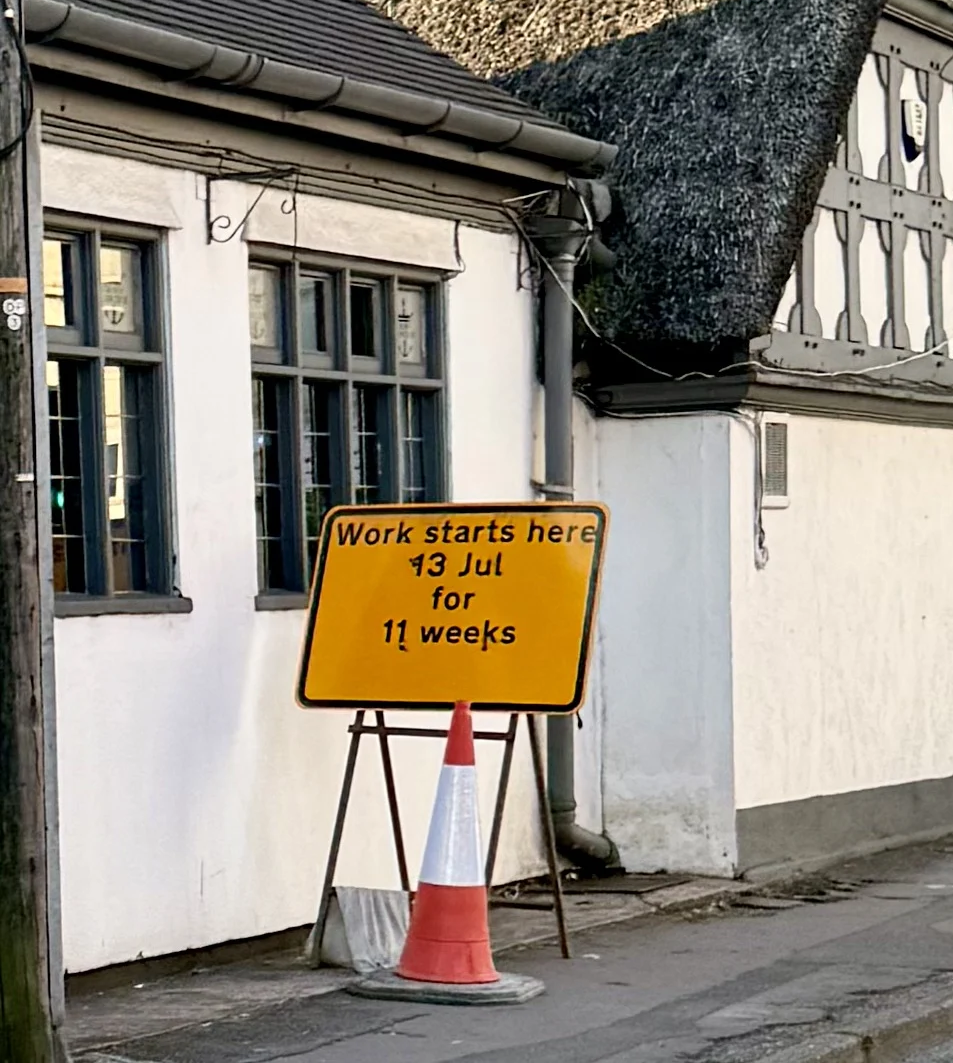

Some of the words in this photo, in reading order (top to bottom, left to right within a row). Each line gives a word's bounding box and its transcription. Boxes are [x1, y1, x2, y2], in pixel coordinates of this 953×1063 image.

[337, 522, 413, 546] Work
[424, 519, 515, 543] starts
[527, 519, 595, 543] here
[412, 552, 446, 577] 13
[458, 551, 503, 577] Jul
[432, 586, 475, 610] for
[383, 620, 407, 643] 11
[420, 620, 516, 644] weeks
